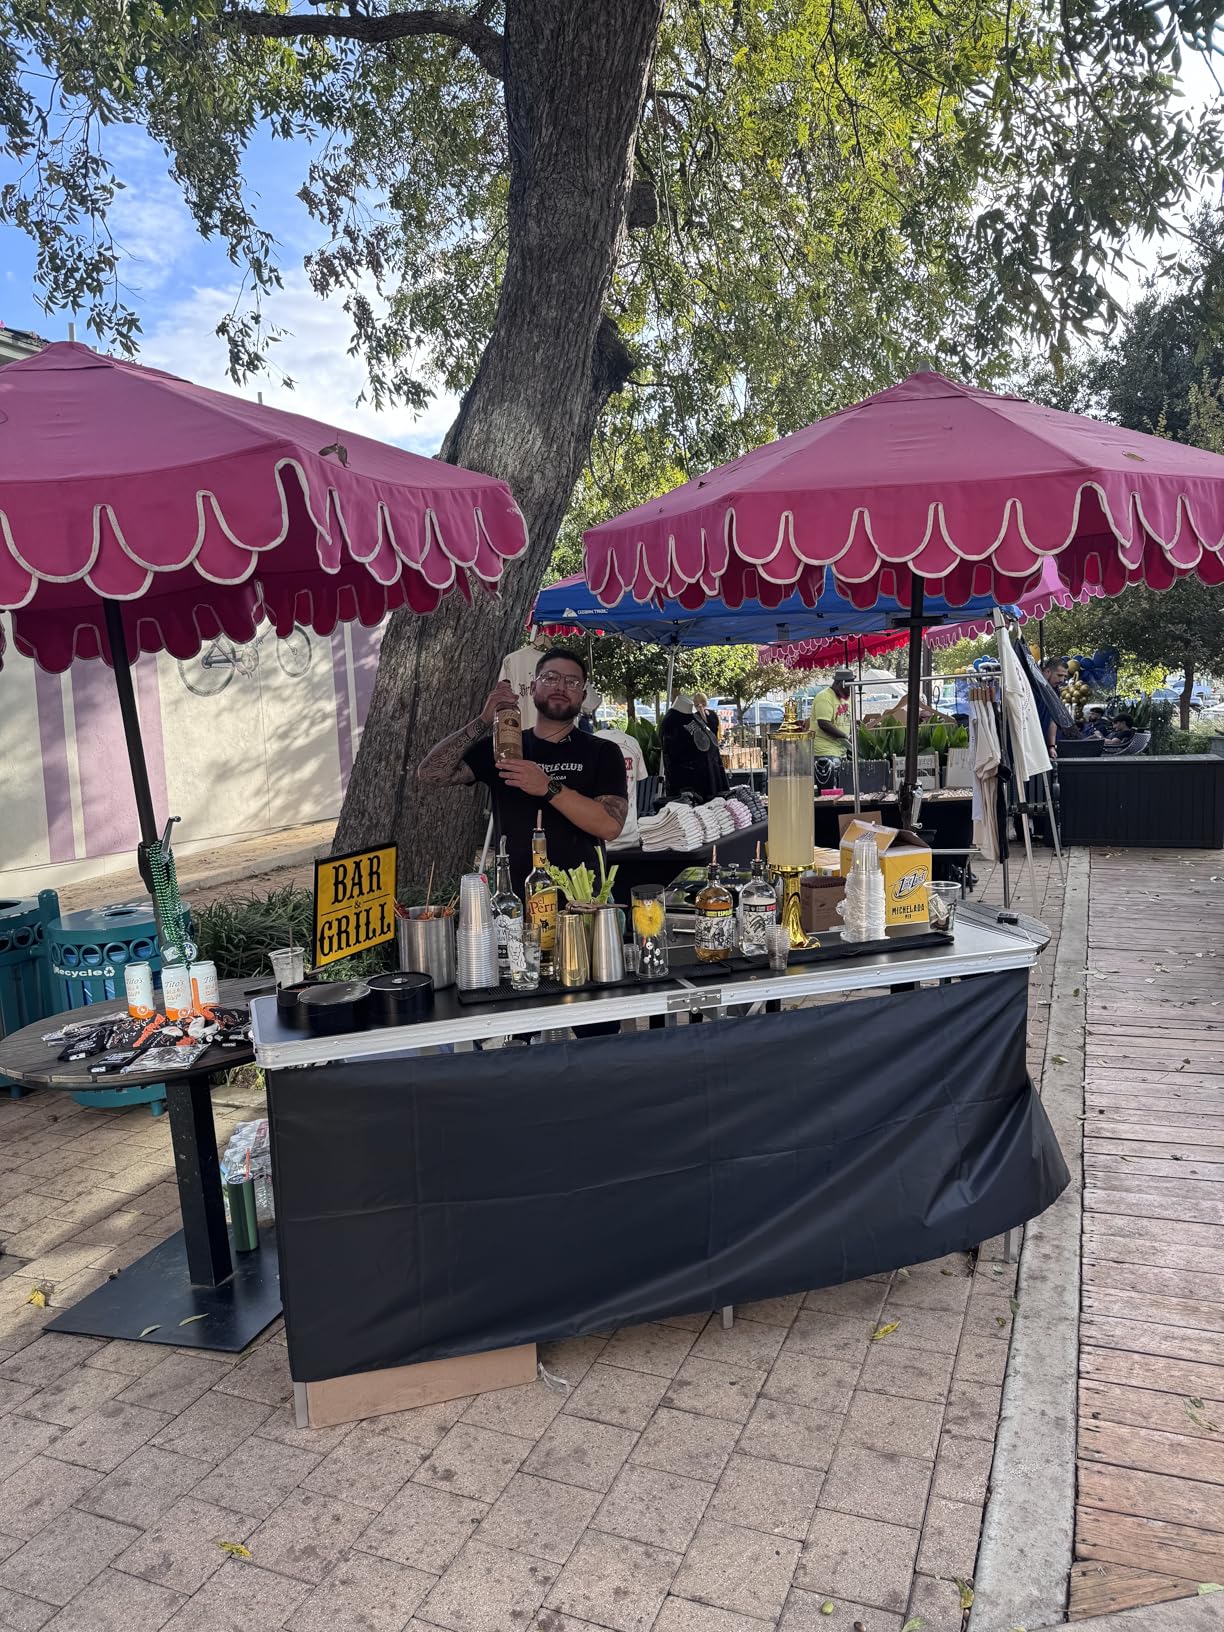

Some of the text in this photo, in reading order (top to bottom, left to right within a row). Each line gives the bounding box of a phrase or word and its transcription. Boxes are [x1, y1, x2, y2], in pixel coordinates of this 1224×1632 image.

[560, 762, 583, 773] CLUB
[331, 854, 382, 905] BAR
[353, 901, 361, 909] &
[891, 903, 925, 916] MICHELADA
[319, 902, 391, 956] GRILL
[53, 964, 103, 978] Recycle
